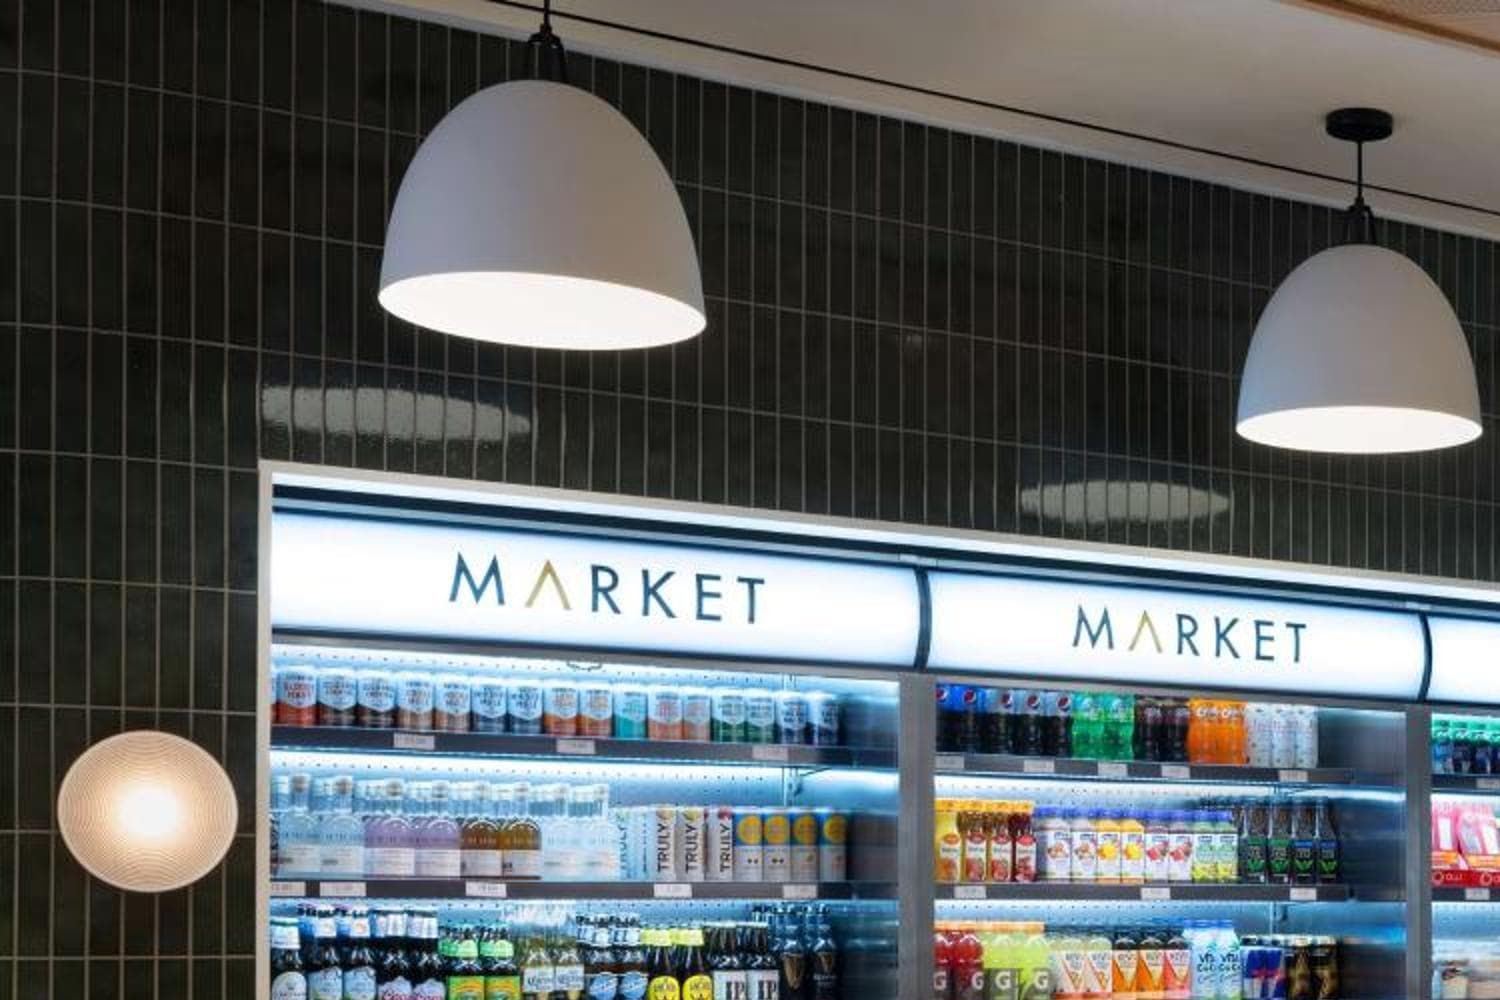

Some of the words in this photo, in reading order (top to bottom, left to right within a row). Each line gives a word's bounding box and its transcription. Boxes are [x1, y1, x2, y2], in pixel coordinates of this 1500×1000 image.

[448, 551, 767, 625] MARKET
[1071, 605, 1308, 664] MARKET
[657, 823, 672, 873] TRULY
[686, 824, 699, 874] TRULY
[720, 824, 733, 873] TRULY
[726, 980, 745, 1000] IP
[758, 980, 778, 1000] IP
[995, 970, 1011, 990] G
[1034, 970, 1049, 990] G
